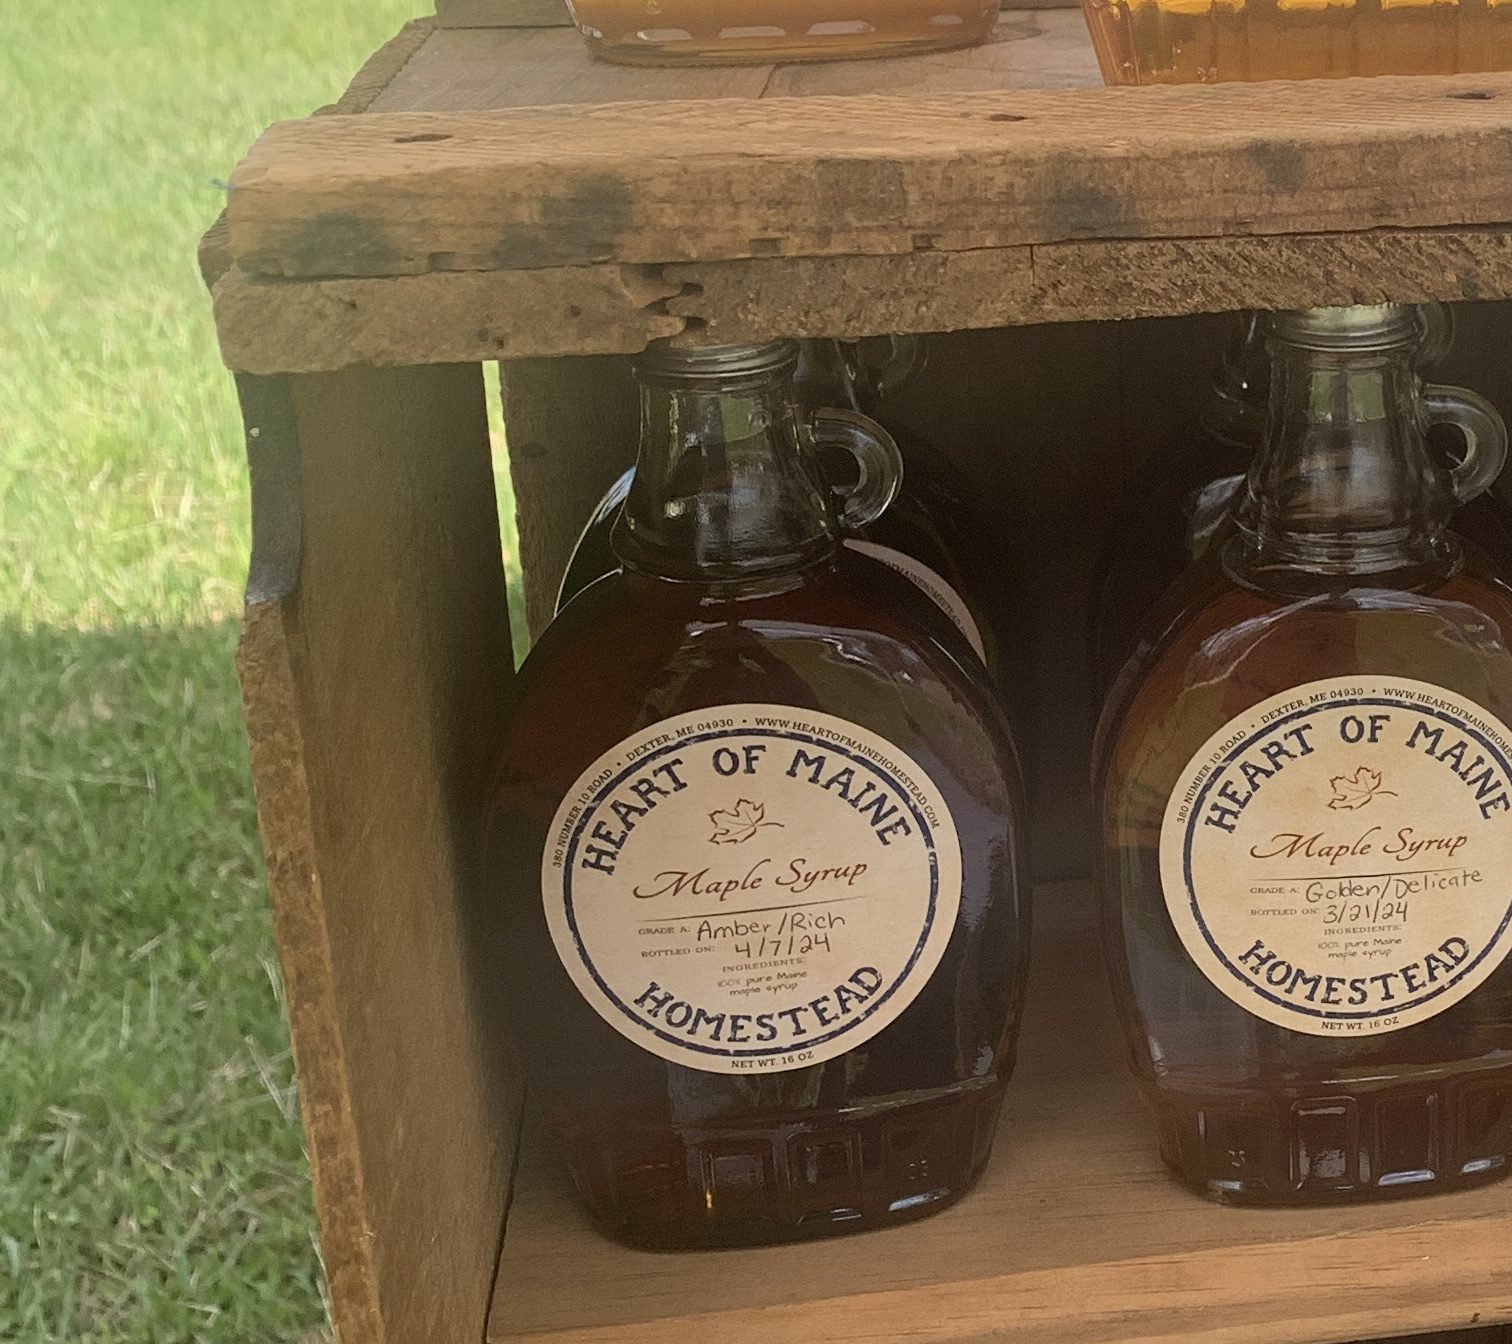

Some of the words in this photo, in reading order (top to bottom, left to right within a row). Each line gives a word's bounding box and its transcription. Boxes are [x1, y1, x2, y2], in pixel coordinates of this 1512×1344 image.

[674, 726, 695, 738] ME
[696, 720, 733, 733] 04930
[1176, 806, 1189, 825] 380
[1183, 764, 1212, 805] NUMBER
[1208, 752, 1222, 764] 10
[1218, 729, 1246, 753] ROAD
[1308, 693, 1327, 704] ME
[1329, 688, 1364, 700] 04930
[581, 758, 687, 876] HEART
[711, 745, 766, 777] OF
[785, 748, 911, 846] MAINE
[1204, 723, 1314, 834] HEART
[1339, 714, 1391, 744] OF
[1405, 720, 1510, 820] MAINE
[632, 858, 771, 902] Maple
[774, 858, 867, 894] Syrup
[1249, 826, 1381, 866] Maple
[1382, 827, 1467, 862] Syrup
[633, 966, 882, 1043] HOMESTEAD
[1238, 936, 1469, 1005] HOMESTEAD
